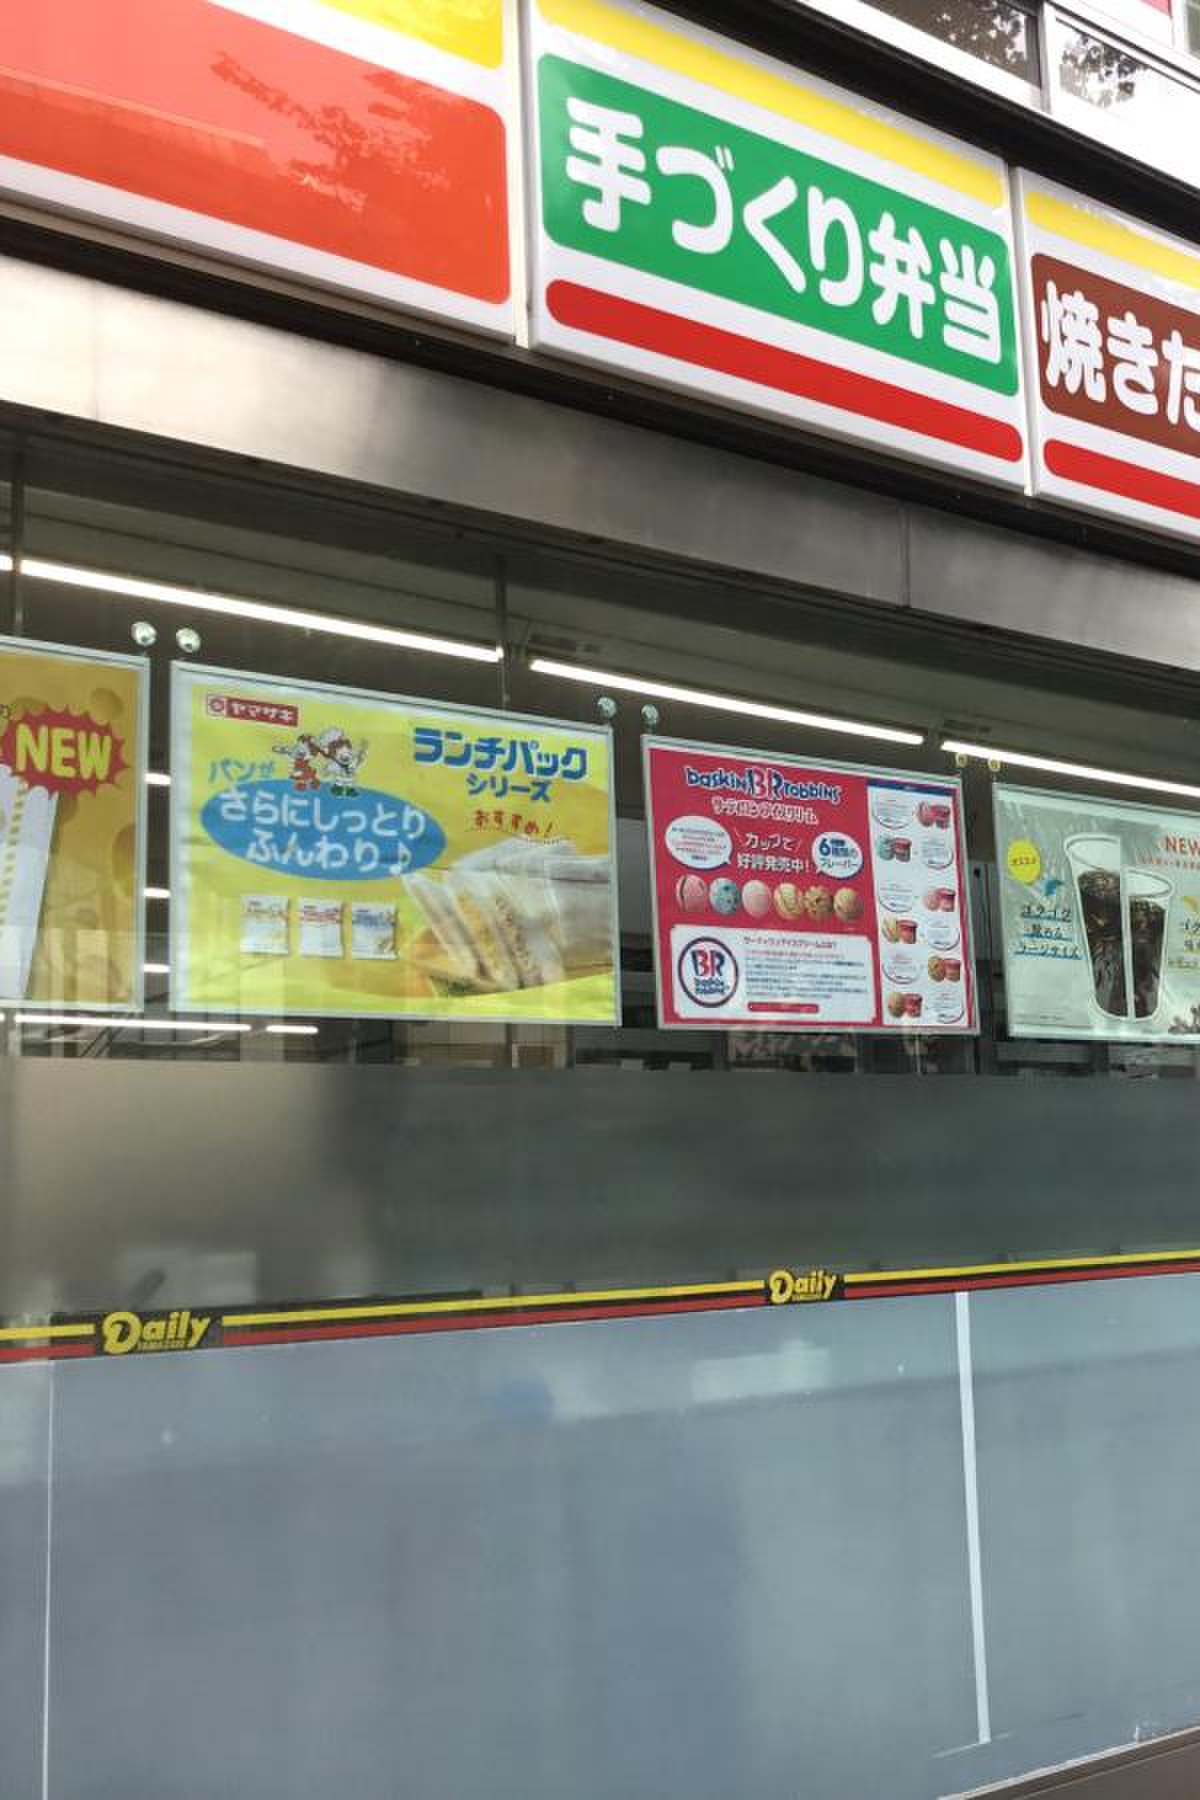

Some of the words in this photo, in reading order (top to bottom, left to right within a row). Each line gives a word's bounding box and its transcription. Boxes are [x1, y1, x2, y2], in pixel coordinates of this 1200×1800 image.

[566, 96, 1002, 364] 手づくり弁当
[15, 722, 112, 781] NEW
[414, 727, 588, 781] ランチパック
[220, 787, 426, 839] さらにしっとり
[466, 773, 552, 802] シリーズ
[769, 1269, 837, 1304] Daily
[102, 1311, 210, 1355] Daily
